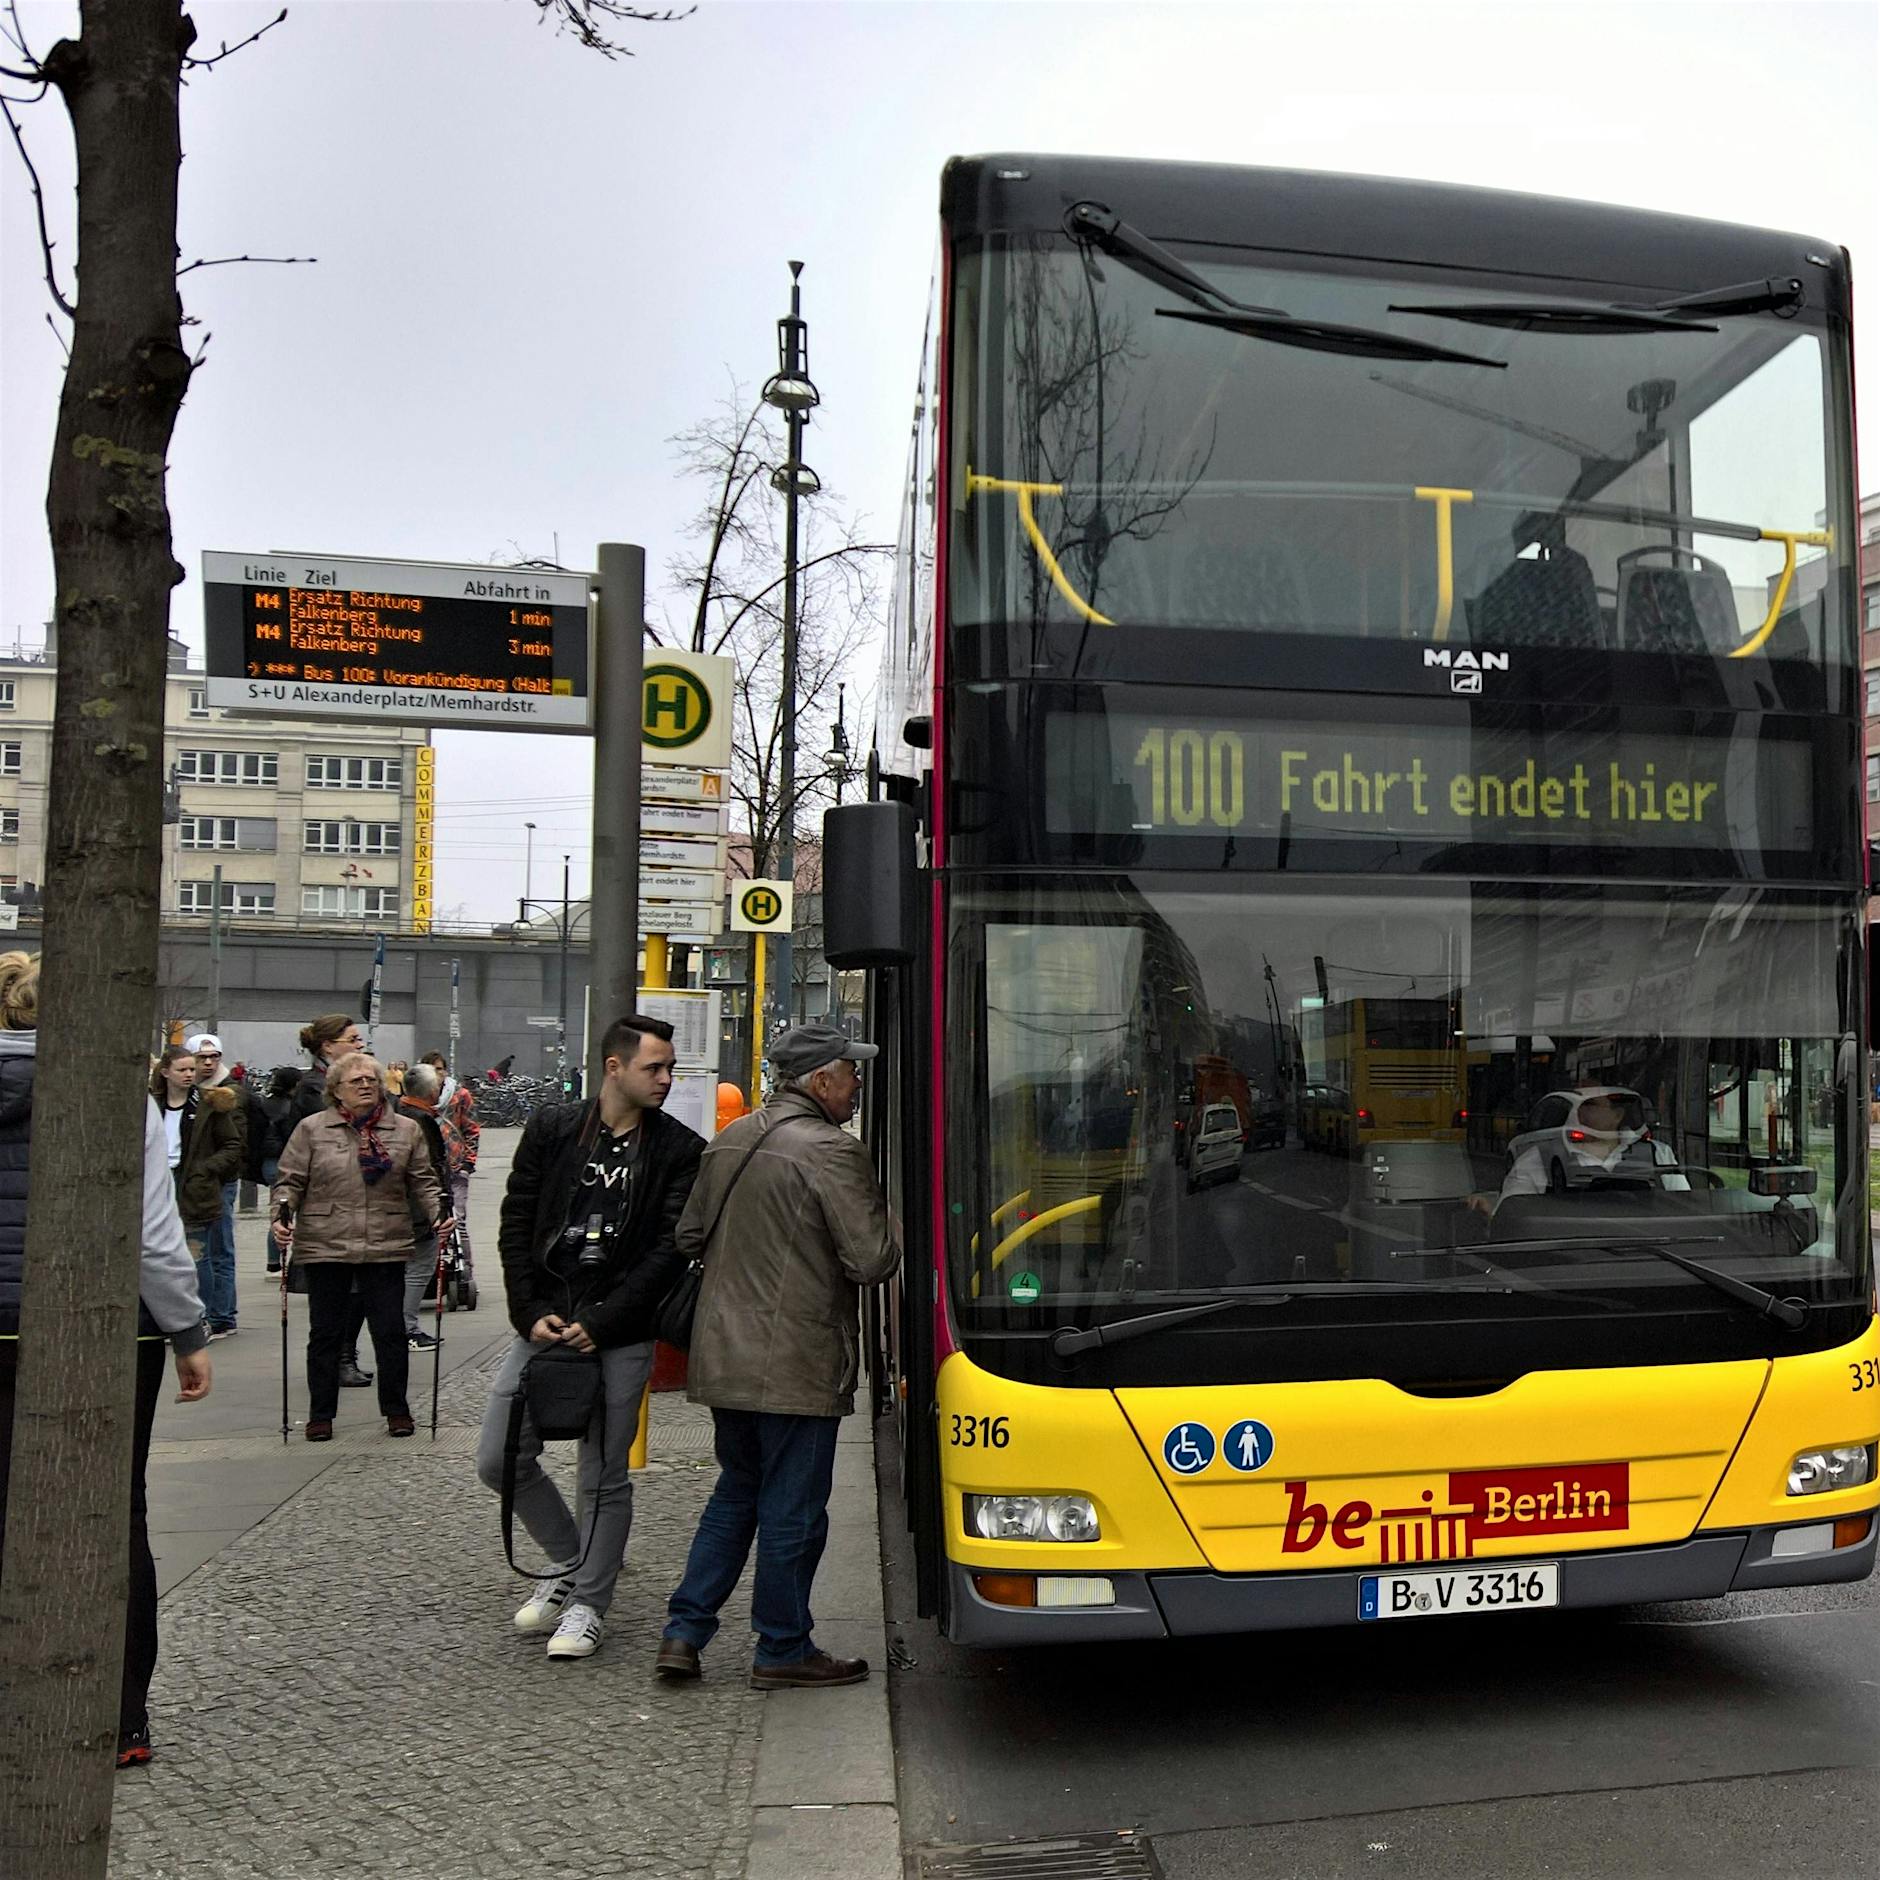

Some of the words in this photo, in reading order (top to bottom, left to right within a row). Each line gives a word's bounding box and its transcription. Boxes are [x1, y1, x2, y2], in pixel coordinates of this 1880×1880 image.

[245, 565, 287, 583] Linie
[305, 569, 337, 586] Ziel
[255, 592, 280, 609] M4
[289, 587, 343, 606] Ersatz
[350, 591, 422, 613] Richtung
[464, 580, 529, 599] Abfahrt
[535, 585, 550, 600] in
[290, 603, 377, 625] Falkenberg
[509, 609, 517, 625] 1
[522, 611, 552, 627] min
[256, 624, 281, 640] M4
[290, 618, 344, 636] Ersatz
[351, 622, 423, 643] Richtung
[290, 634, 378, 655] Falkenberg
[508, 639, 519, 655] 3
[522, 641, 552, 656] min
[1424, 648, 1509, 670] MAN
[303, 664, 334, 681] Bus
[382, 668, 505, 692] Vorankündigung
[248, 683, 286, 700] S+U
[292, 686, 537, 713] Alexanderplatz/Memhardstr.
[1134, 728, 1244, 827] 100
[1280, 751, 1429, 815] Fahrt
[1450, 759, 1590, 819] endet
[1610, 762, 1717, 822] hier
[655, 877, 678, 886] endet
[680, 878, 696, 887] hier
[674, 911, 692, 921] Berg
[1020, 1273, 1030, 1288] 4
[950, 1413, 1010, 1449] 3316
[1281, 1480, 1373, 1553] be
[1484, 1481, 1611, 1524] Berlin
[1365, 1601, 1374, 1612] D
[1436, 1577, 1455, 1608] V
[1466, 1571, 1544, 1606] 3316
